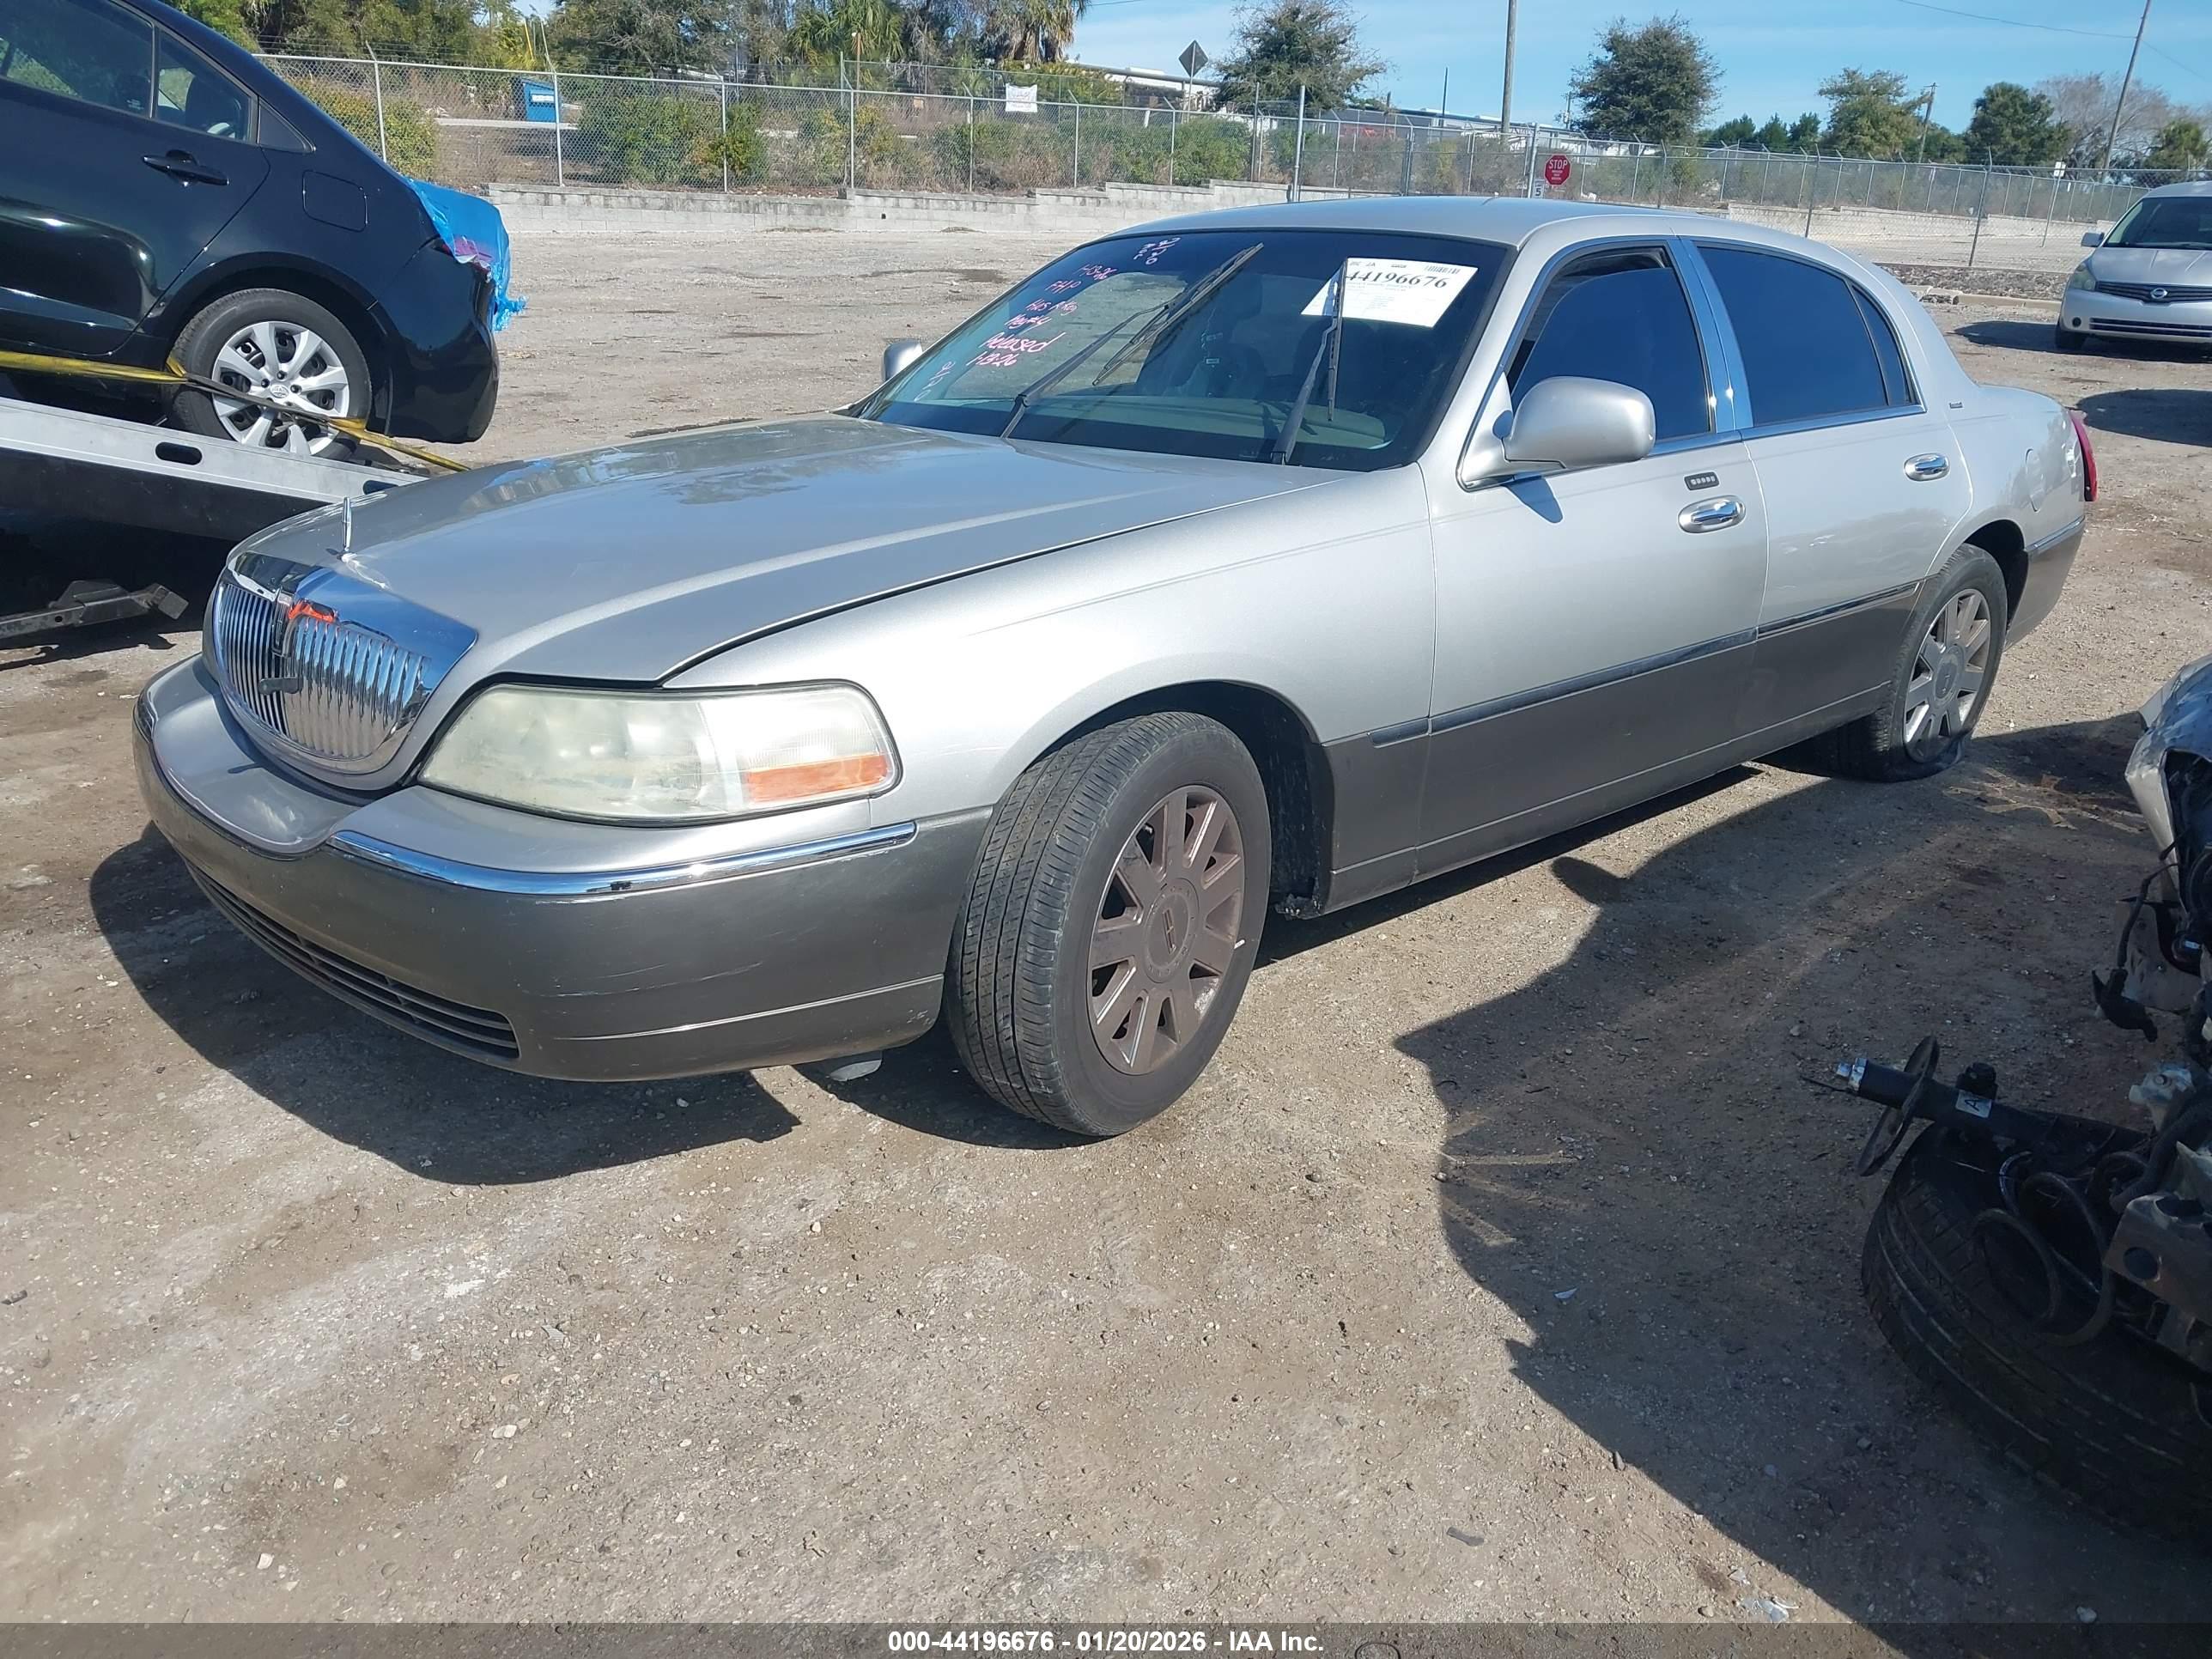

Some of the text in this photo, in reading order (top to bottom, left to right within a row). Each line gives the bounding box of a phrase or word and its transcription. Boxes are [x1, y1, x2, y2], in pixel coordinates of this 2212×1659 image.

[1548, 159, 1568, 170] STOP
[1534, 187, 1541, 197] 5
[1345, 270, 1450, 289] 44196676
[1044, 280, 1082, 294] FHP
[1024, 298, 1052, 312] Has
[976, 331, 1066, 353] Released
